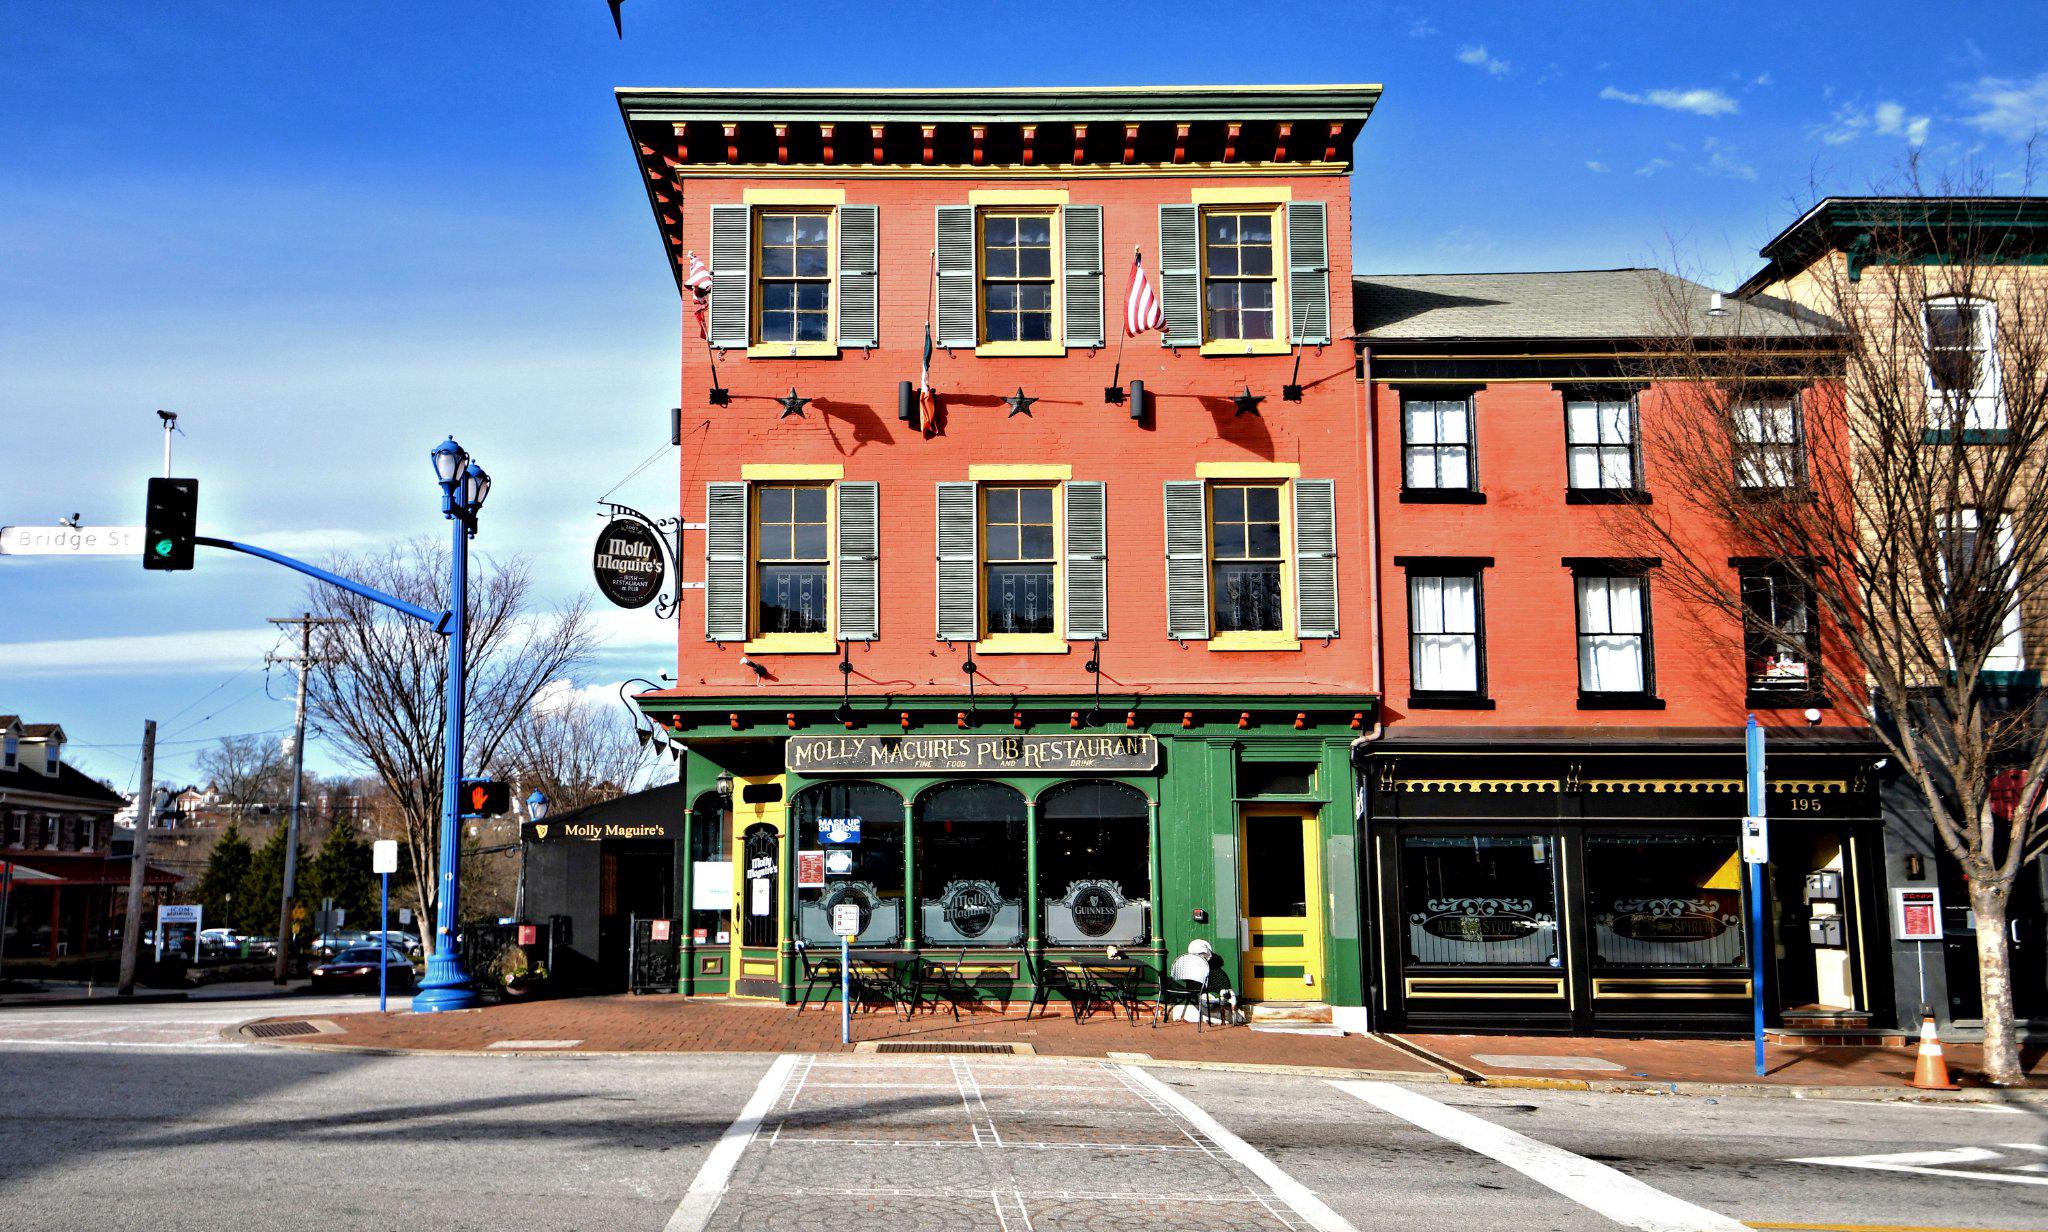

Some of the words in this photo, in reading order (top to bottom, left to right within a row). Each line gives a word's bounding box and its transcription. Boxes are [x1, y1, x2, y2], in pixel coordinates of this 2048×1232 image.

[19, 532, 97, 551] Bridge
[108, 532, 129, 546] St
[609, 538, 652, 562] Molly
[597, 553, 663, 573] Maguire's
[612, 579, 648, 587] RESTAURANT
[796, 738, 866, 767] MOLLY
[977, 738, 1019, 766] PUB
[1023, 737, 1150, 768] RESTAURANT
[914, 760, 932, 768] FINE
[946, 760, 966, 768] FOOD
[1070, 759, 1095, 767] DRINK
[1791, 799, 1821, 811] 195
[818, 818, 846, 826] MASK
[847, 818, 861, 826] UP
[565, 824, 602, 837] Molly
[605, 824, 665, 838] Maguire's
[752, 856, 772, 868] Molly
[953, 893, 988, 908] Molly
[1074, 905, 1115, 915] GUINNESS
